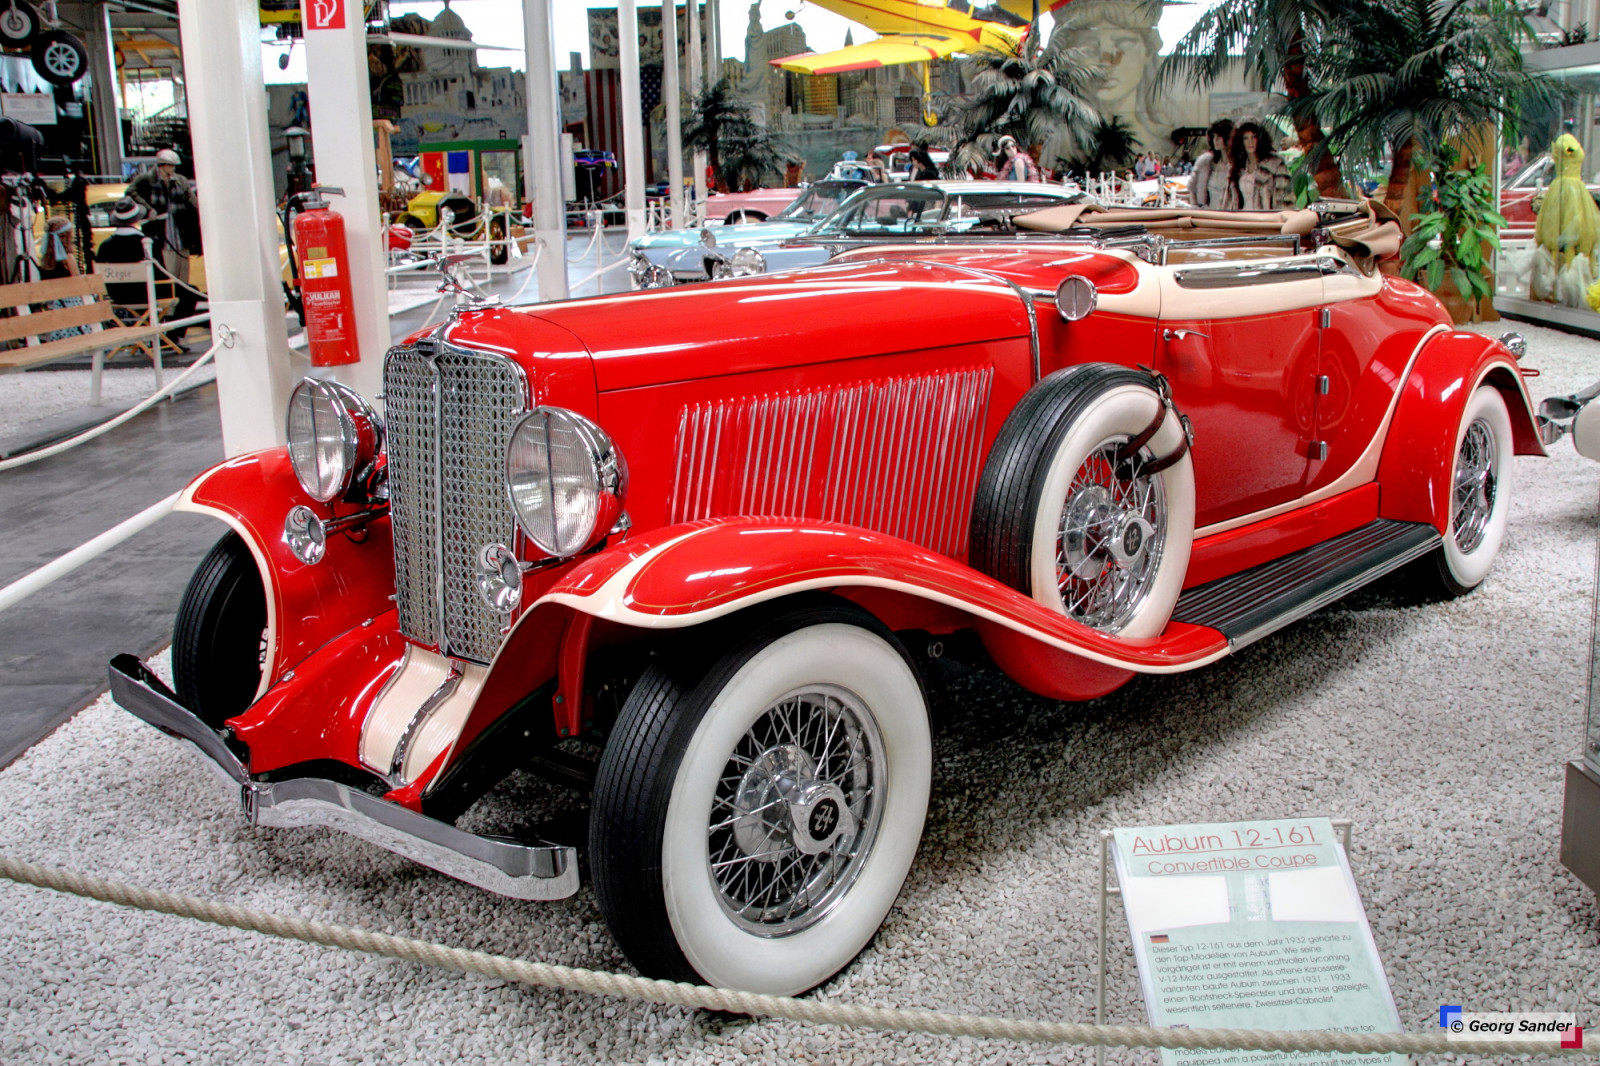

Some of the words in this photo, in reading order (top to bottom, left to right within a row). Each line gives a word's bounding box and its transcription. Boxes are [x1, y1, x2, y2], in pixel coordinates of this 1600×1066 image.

[1132, 835, 1223, 853] Auburn
[1232, 826, 1317, 847] 12-161
[1148, 856, 1250, 874] Convertible
[1255, 852, 1317, 869] Coupe
[1156, 964, 1200, 973] Vorgänger
[1238, 959, 1265, 967] einem
[1267, 957, 1308, 965] kraftvollen
[1310, 954, 1350, 964] Lycoming
[1174, 952, 1230, 962] Top-Modellen
[1158, 975, 1204, 983] V-12-Motor
[1207, 970, 1258, 980] ausgestattet.
[1276, 967, 1302, 975] offene
[1161, 985, 1200, 993] varianten
[1231, 980, 1259, 989] Auburn
[1262, 978, 1300, 987] zwischen
[1190, 989, 1276, 1002] Bootsheck-Speedster
[1166, 1004, 1210, 1014] wesentlich
[1177, 1058, 1220, 1066] equipped
[1250, 1052, 1288, 1063] powerful
